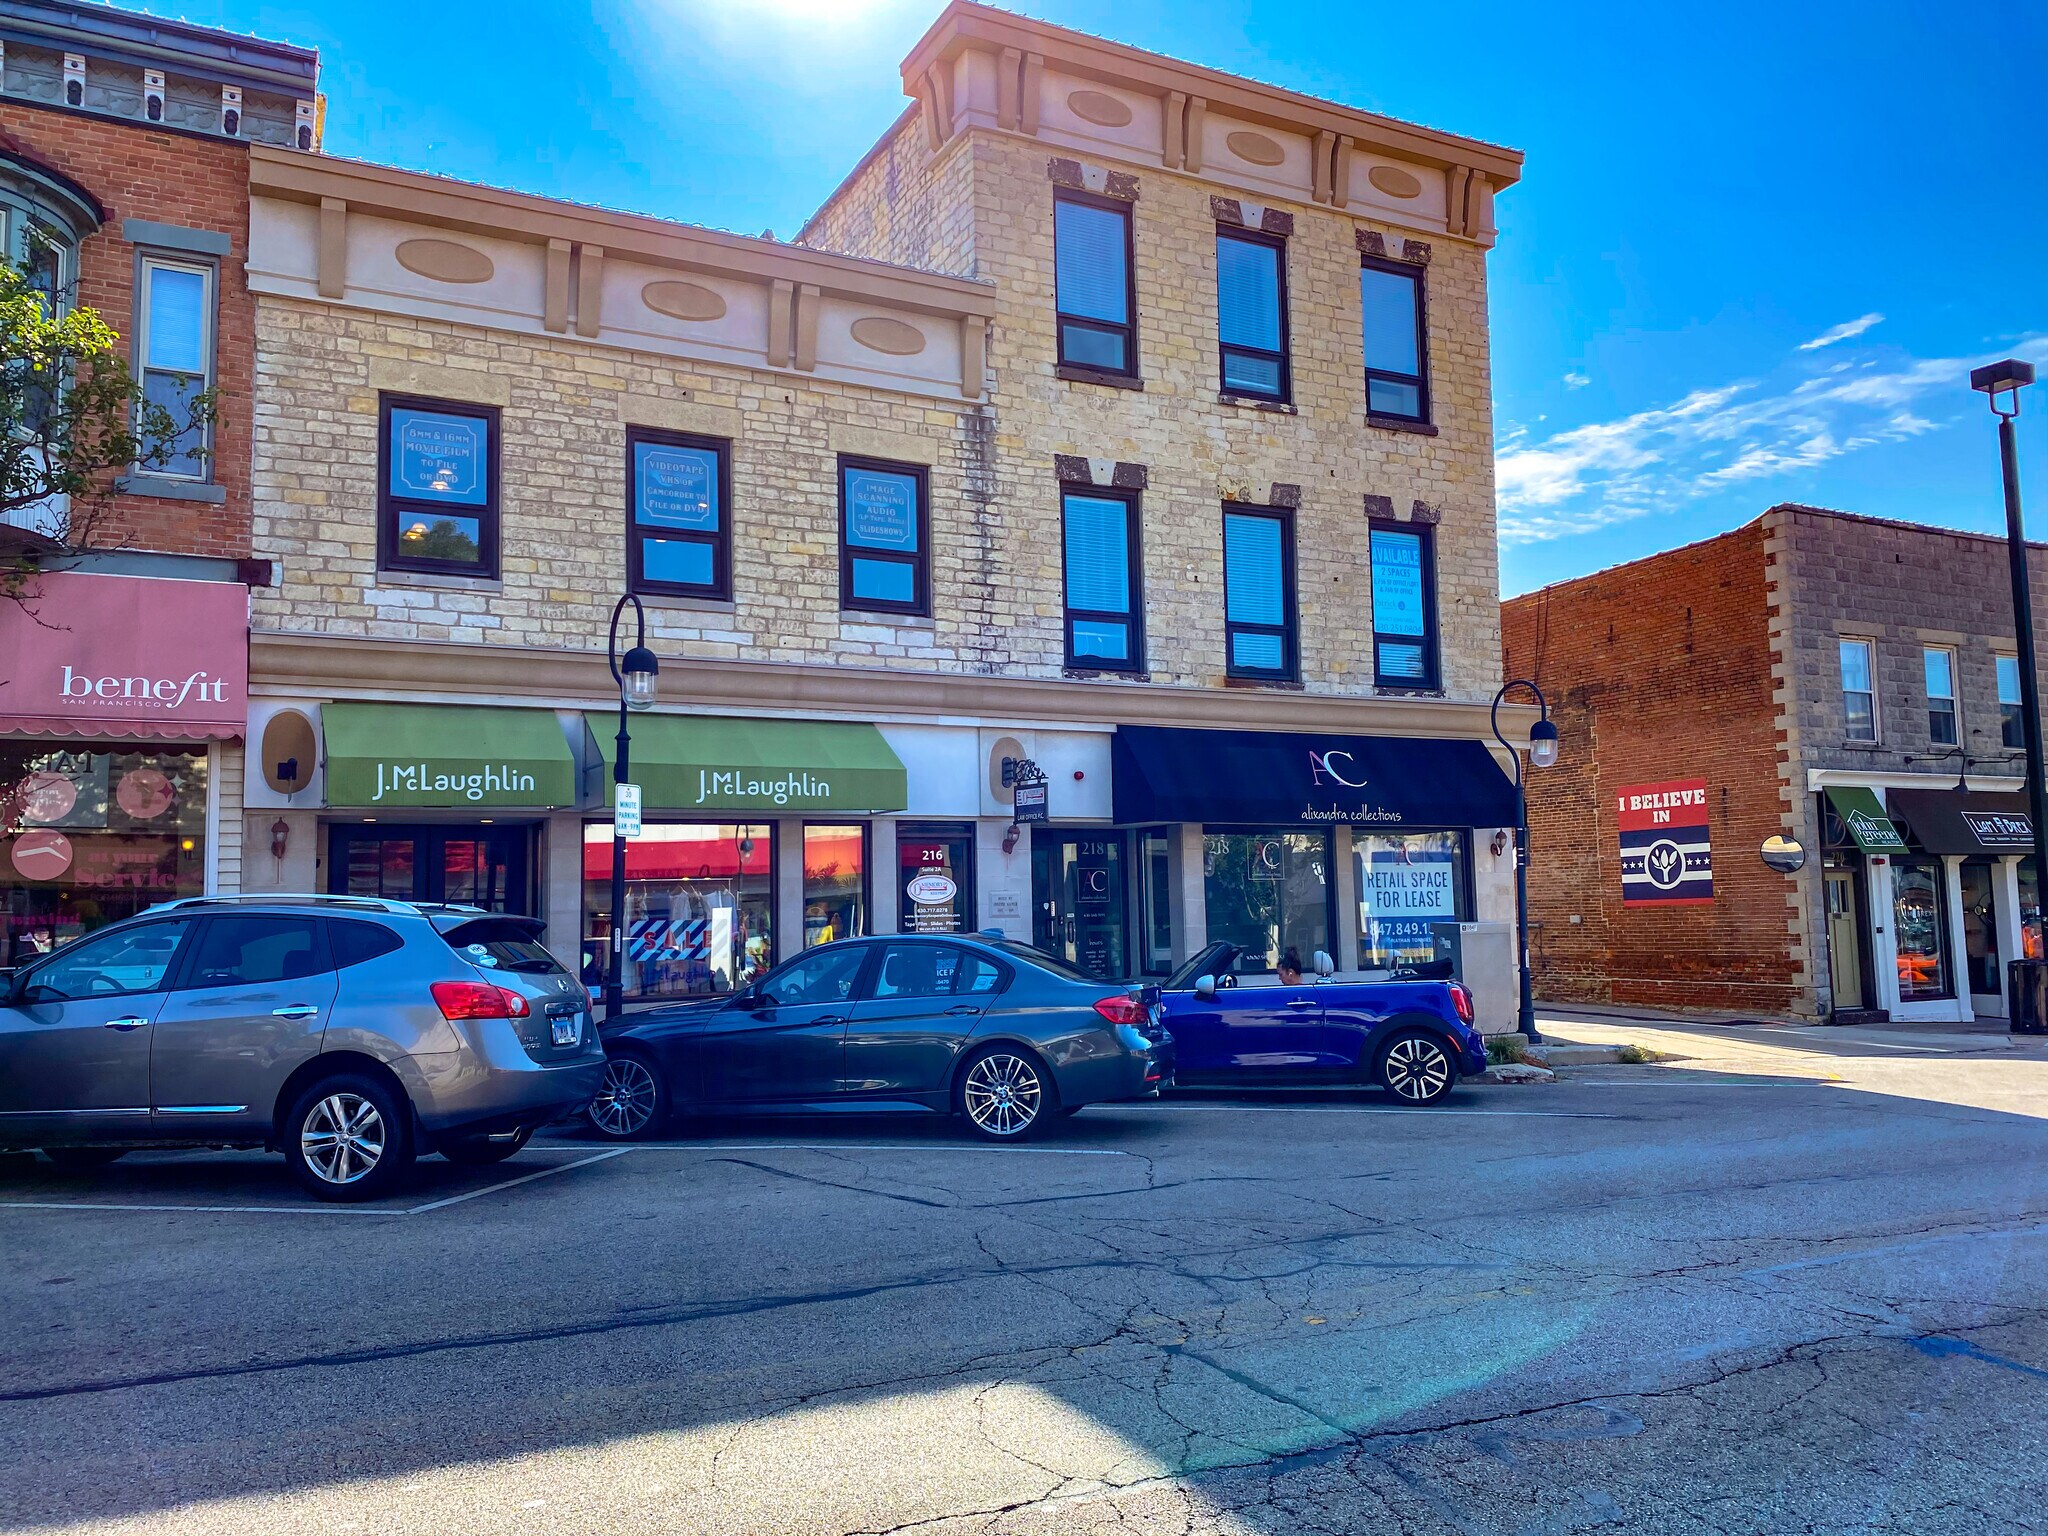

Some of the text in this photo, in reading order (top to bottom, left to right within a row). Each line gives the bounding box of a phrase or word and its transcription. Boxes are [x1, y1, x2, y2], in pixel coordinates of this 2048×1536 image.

[406, 442, 469, 457] MOVIE FILM
[421, 459, 457, 470] TO FILE
[649, 460, 704, 475] VIDEOTAPE
[420, 472, 458, 483] OR DVD
[660, 475, 680, 485] VHS
[866, 484, 895, 495] IMAGE
[649, 500, 668, 509] FILE
[670, 503, 682, 511] OR
[857, 492, 905, 506] SCANNING
[866, 506, 896, 516] AUDIO
[859, 524, 904, 537] SLIDESHOWS
[1372, 546, 1419, 566] AVAILABLE
[1381, 566, 1411, 578] 2 SPACES
[58, 665, 229, 709] benefit
[93, 699, 162, 708] FRANCISCO
[619, 801, 637, 809] MINUTE
[1618, 788, 1706, 812] I BELIEVE
[618, 812, 638, 820] PARKING
[1301, 802, 1402, 822] alixandra collections
[1652, 810, 1670, 823] IN
[1849, 816, 1879, 835] john
[1861, 830, 1898, 845] greene
[1081, 841, 1104, 855] 218
[1209, 841, 1230, 854] 218
[922, 850, 943, 861] 216
[1367, 871, 1448, 889] RETAIL SPACE
[1376, 890, 1442, 908] FOR LEASE
